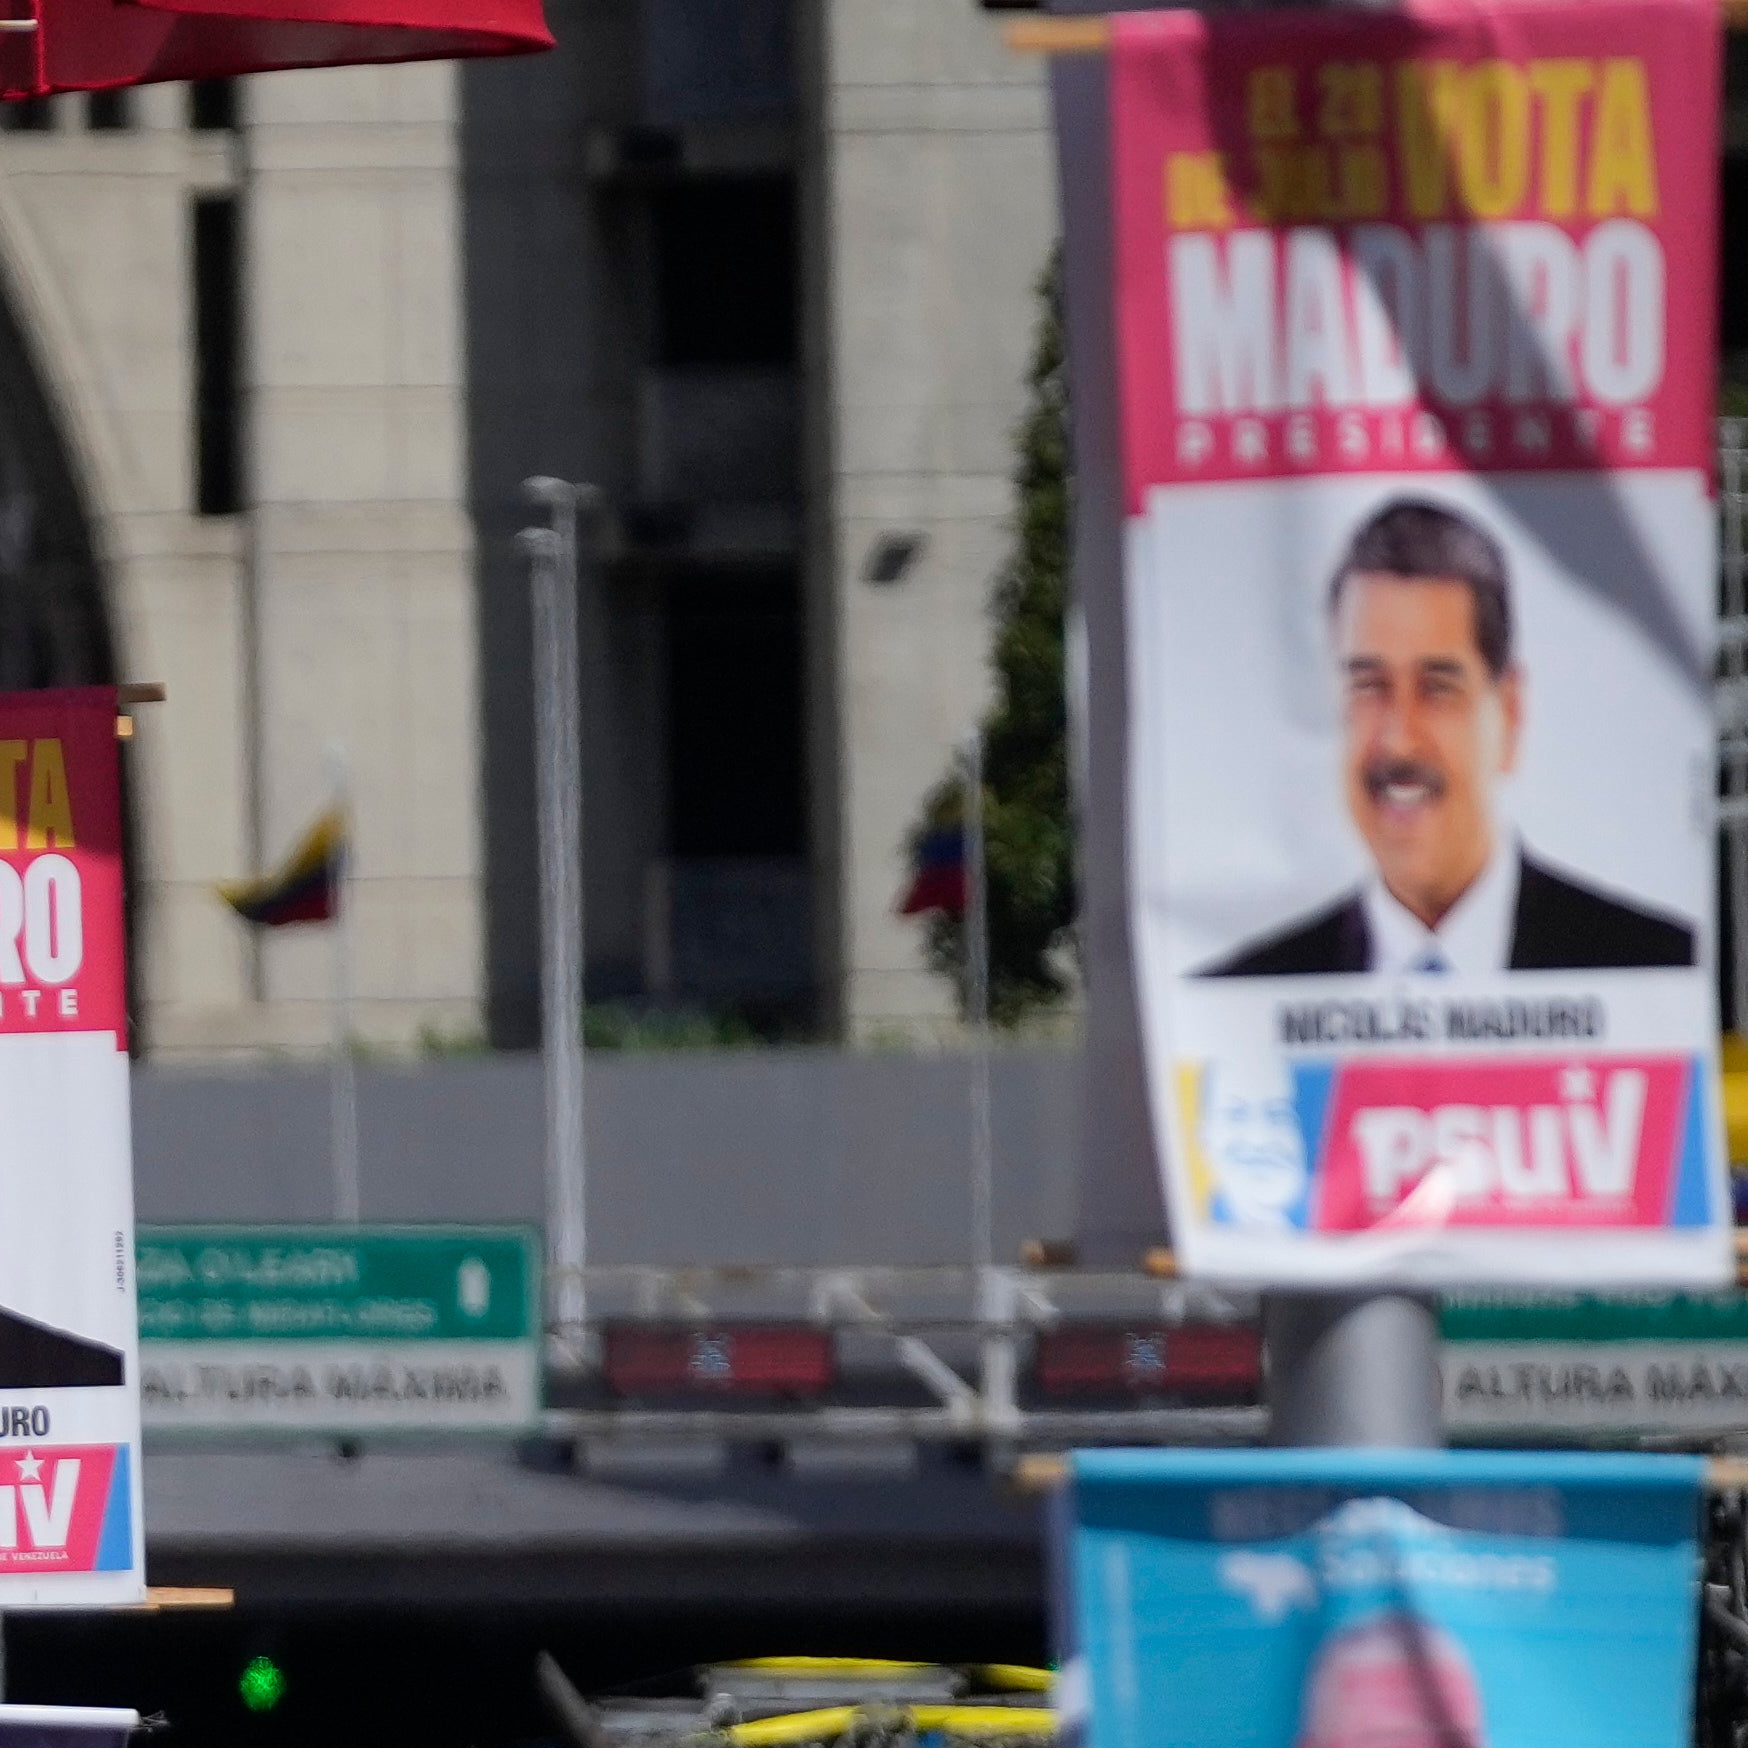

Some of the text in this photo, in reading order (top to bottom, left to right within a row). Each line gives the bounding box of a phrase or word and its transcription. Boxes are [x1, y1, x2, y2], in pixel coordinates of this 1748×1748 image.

[1396, 56, 1661, 220] VOTA
[1167, 216, 1667, 419] MADURO
[1455, 1361, 1636, 1402] ALTURA
